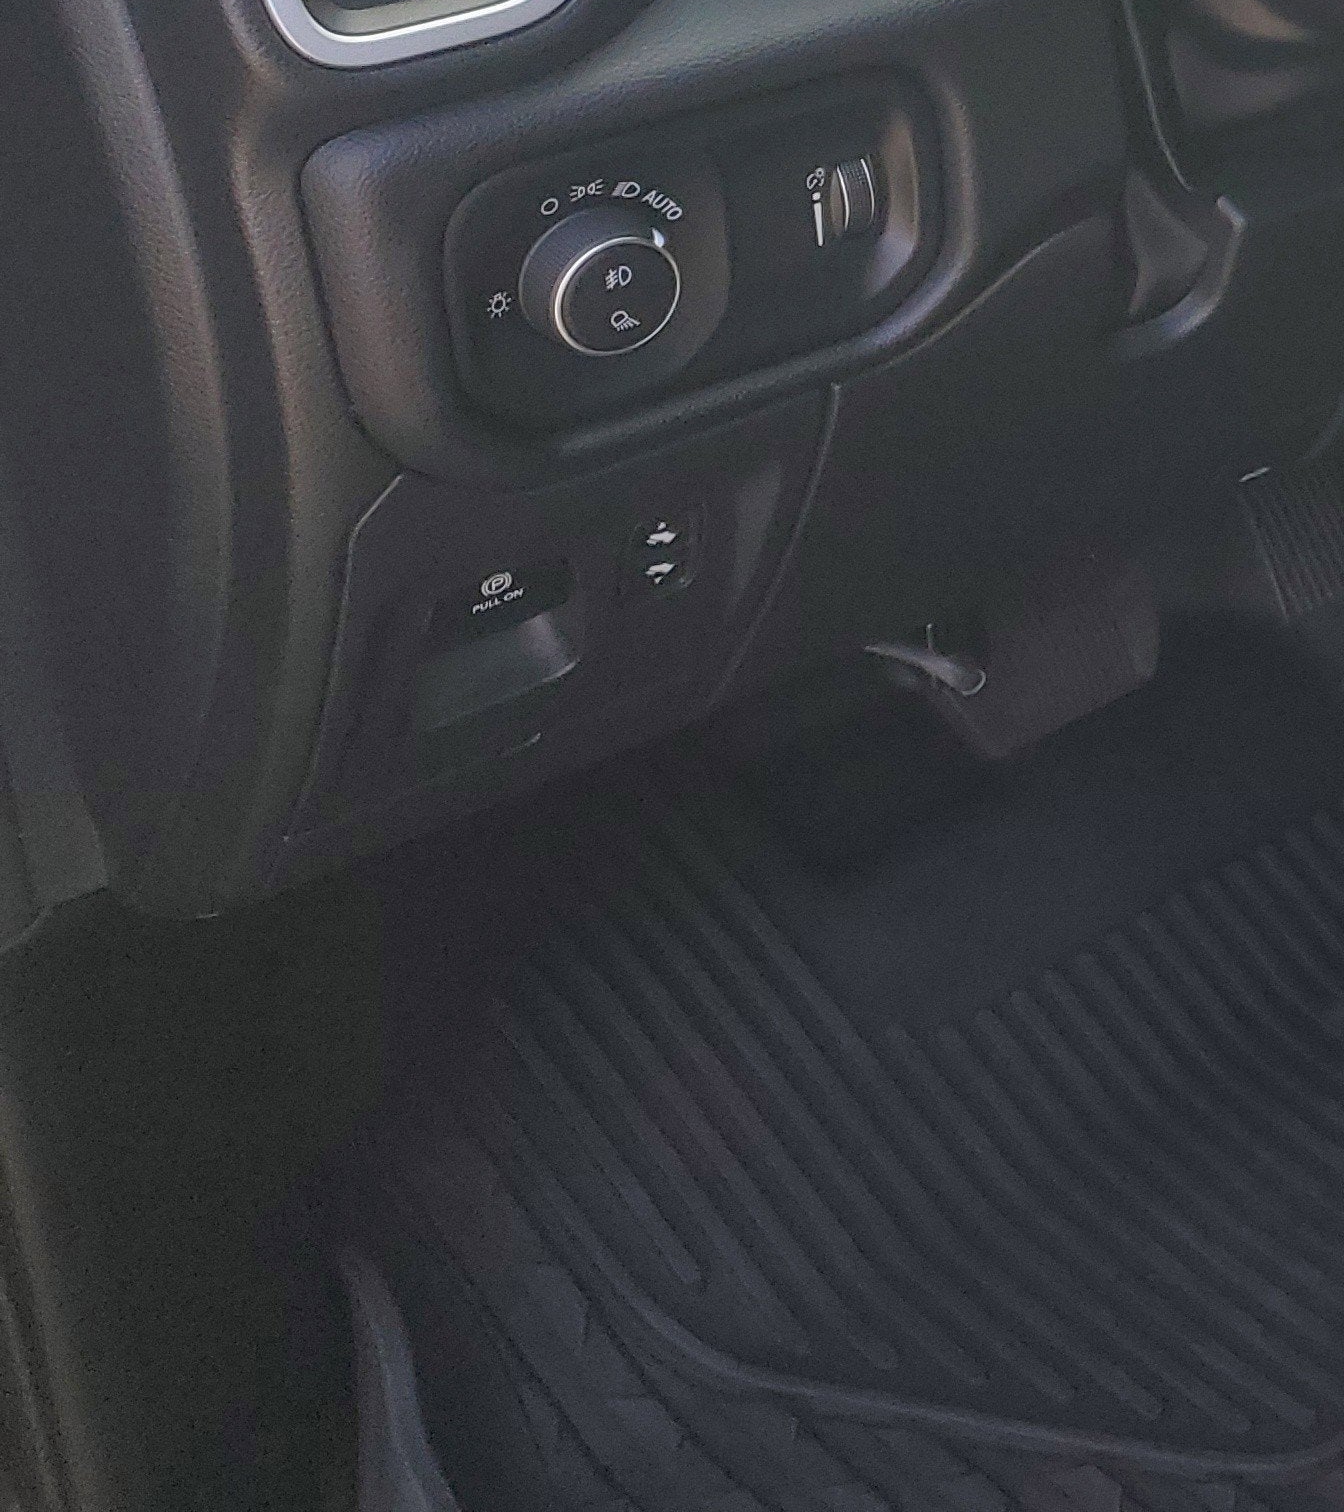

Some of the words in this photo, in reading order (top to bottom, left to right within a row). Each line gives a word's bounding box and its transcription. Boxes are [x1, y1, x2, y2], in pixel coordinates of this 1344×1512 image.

[641, 190, 684, 221] AUTO
[472, 597, 502, 615] PULL
[504, 587, 524, 602] ON
